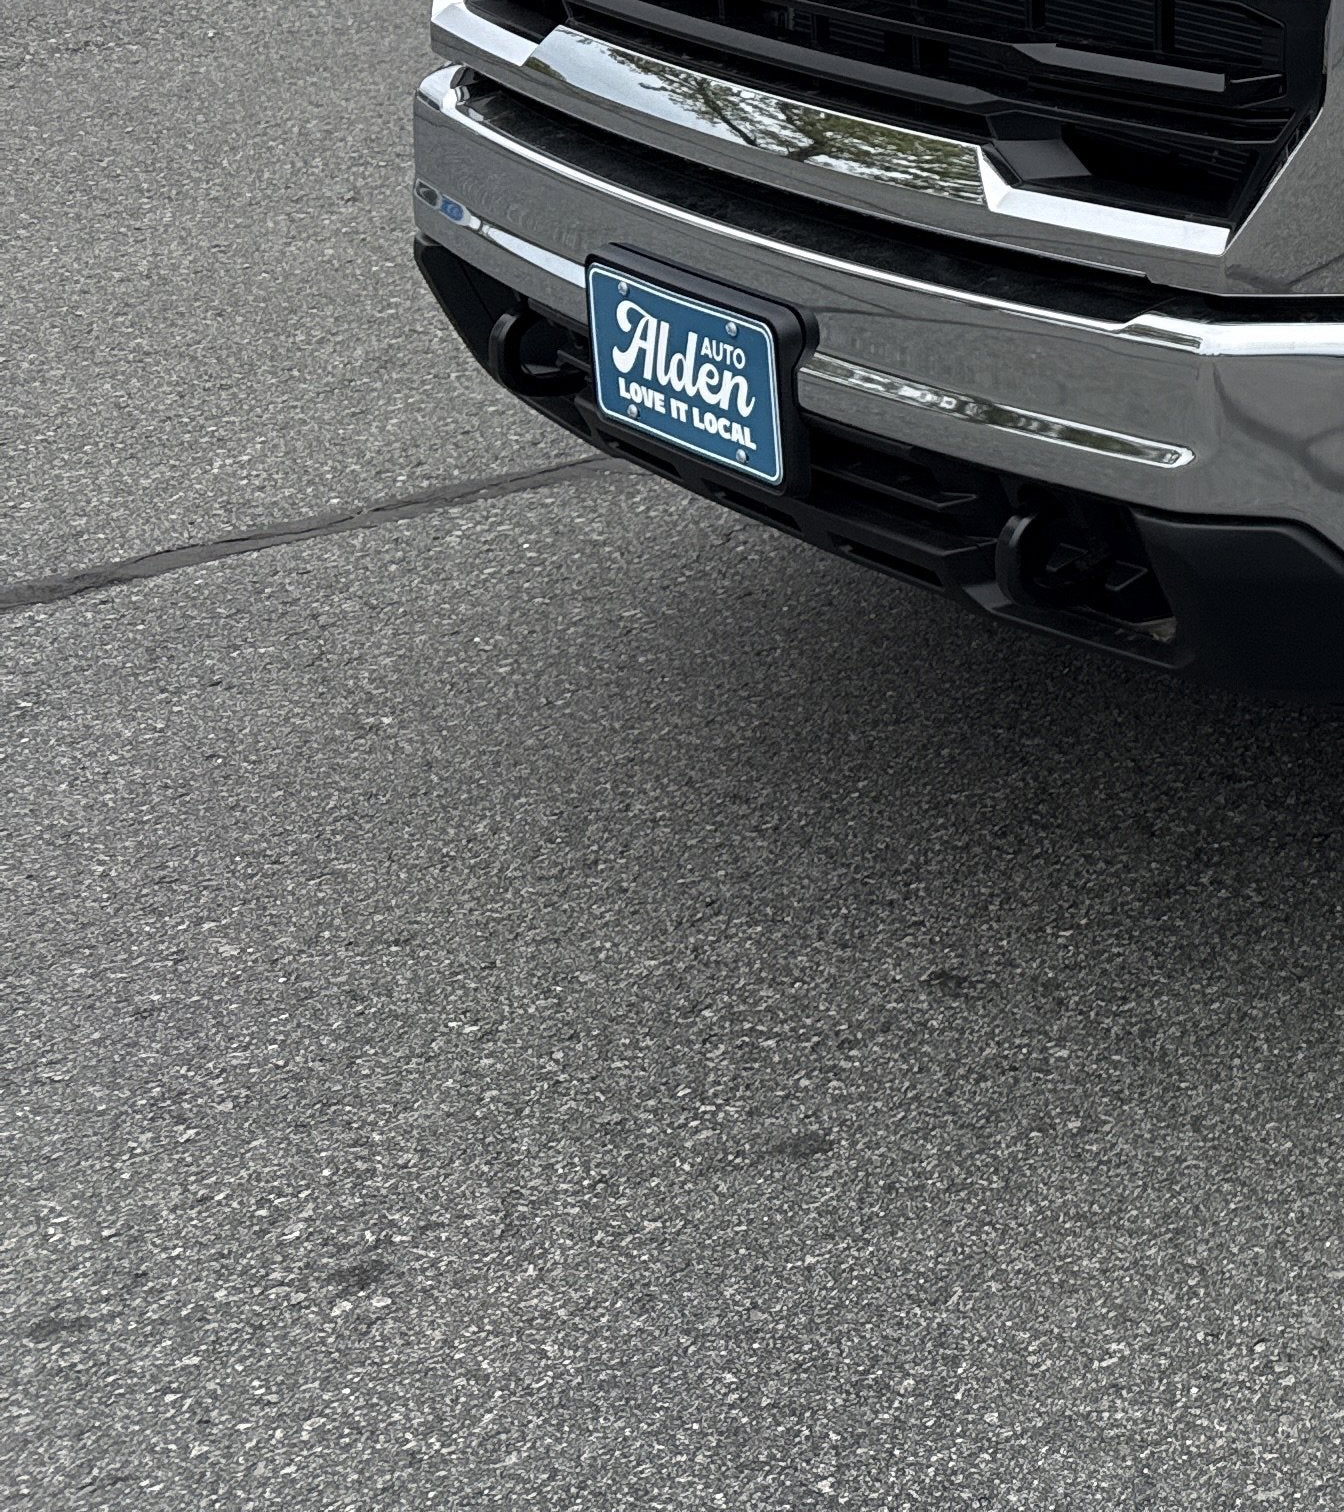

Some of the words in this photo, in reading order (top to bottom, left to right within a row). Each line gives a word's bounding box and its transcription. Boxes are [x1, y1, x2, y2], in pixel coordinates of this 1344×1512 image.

[612, 300, 755, 417] Alden
[701, 337, 746, 370] AUTO
[618, 377, 666, 414] LOVE
[670, 398, 688, 423] IT
[692, 408, 757, 451] LOCAL
